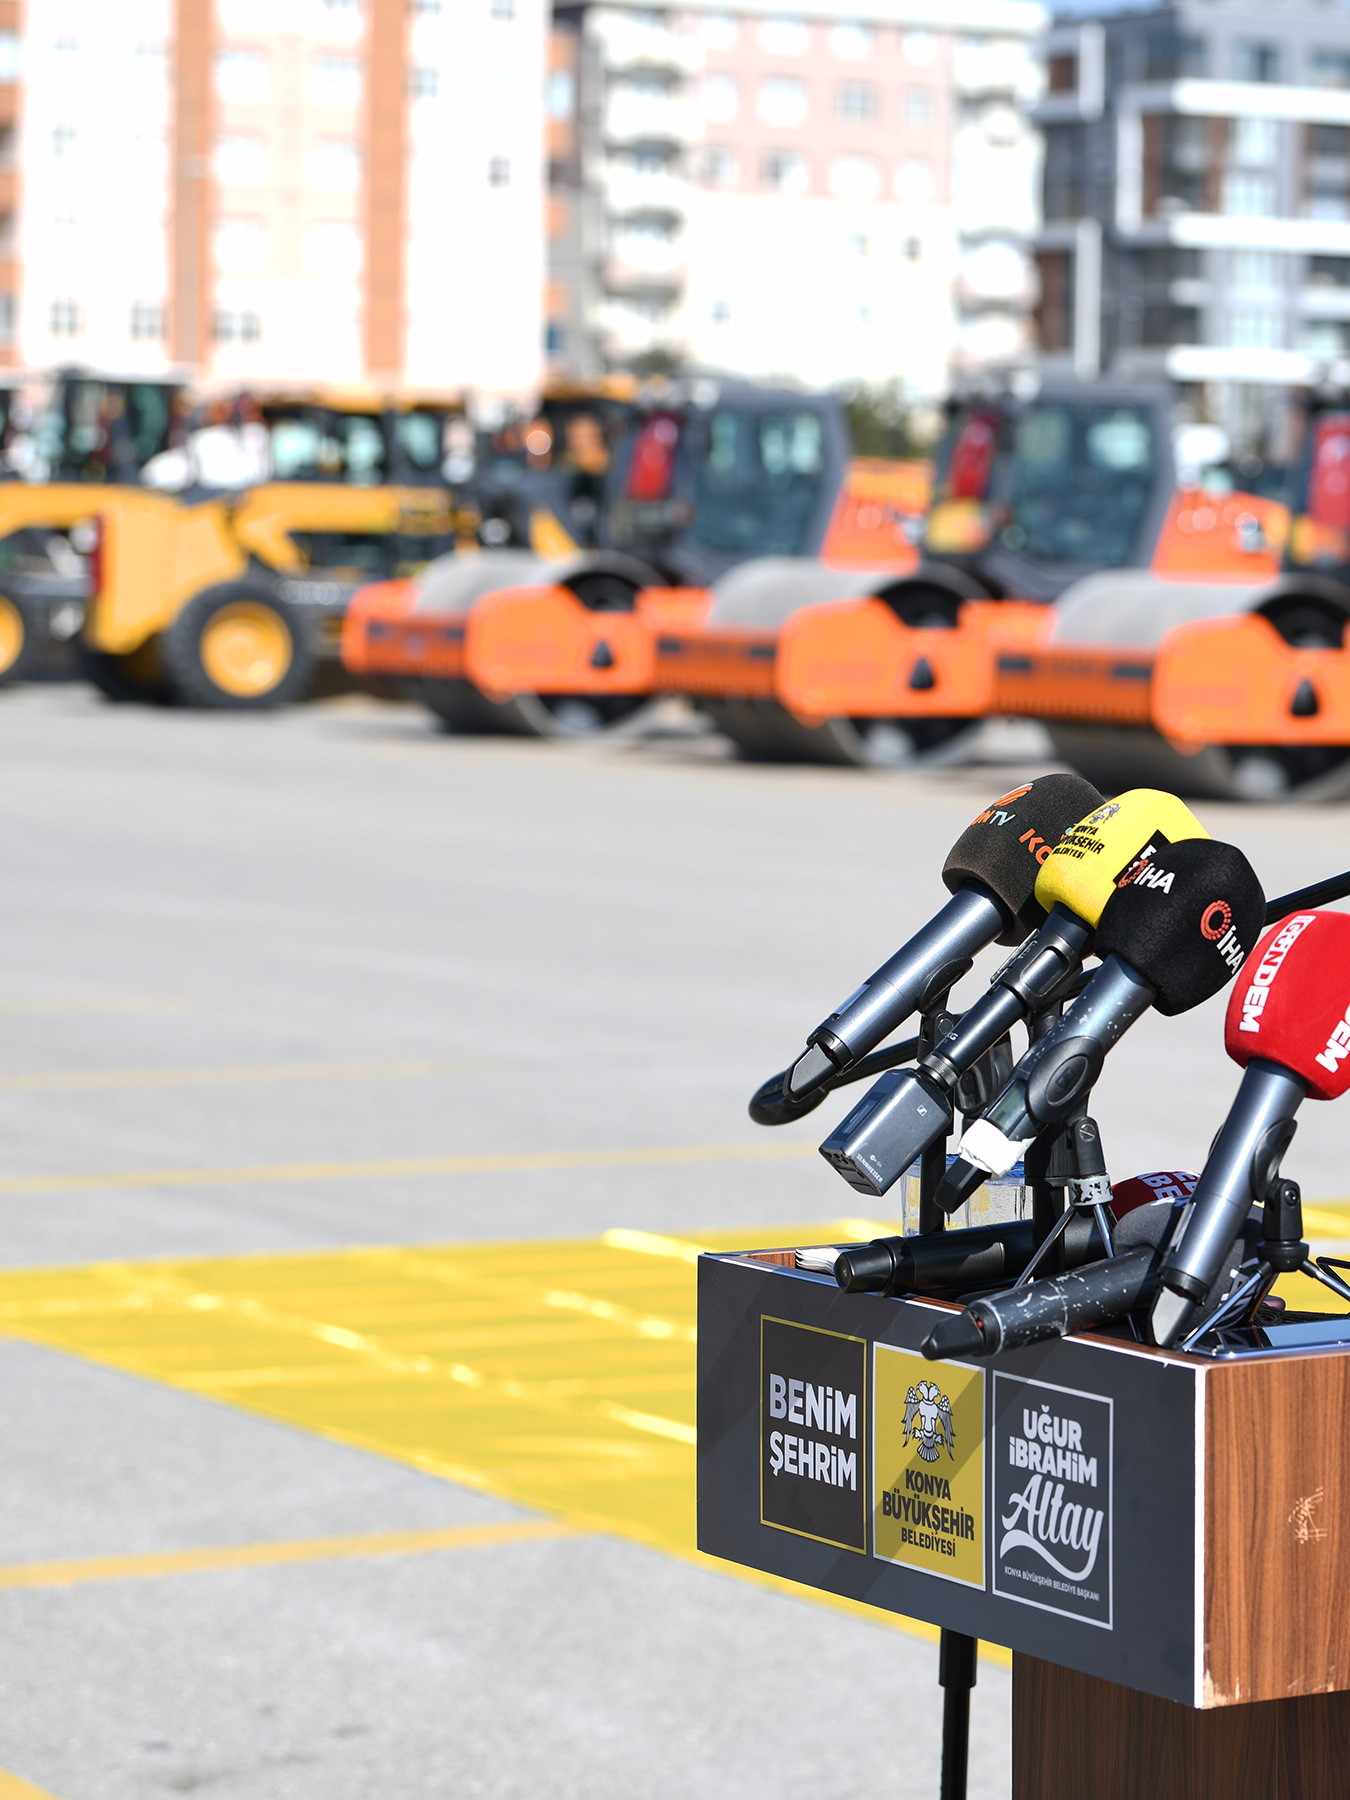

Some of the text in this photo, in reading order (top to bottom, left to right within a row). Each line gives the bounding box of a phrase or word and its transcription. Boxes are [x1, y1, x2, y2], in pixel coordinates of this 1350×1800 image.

[1239, 916, 1312, 1033] GÜNDEM
[769, 1372, 857, 1439] BENİM
[1023, 1404, 1083, 1452] UĞUR
[769, 1430, 857, 1491] ŞEHRİM
[905, 1468, 952, 1501] KONYA
[1009, 1436, 1098, 1488] İBRAHİM
[882, 1488, 975, 1541] BÜYÜKŞEHİR
[1000, 1474, 1105, 1582] Altay
[901, 1527, 956, 1557] BELEDİYESİ
[1004, 1565, 1022, 1579] KONYA
